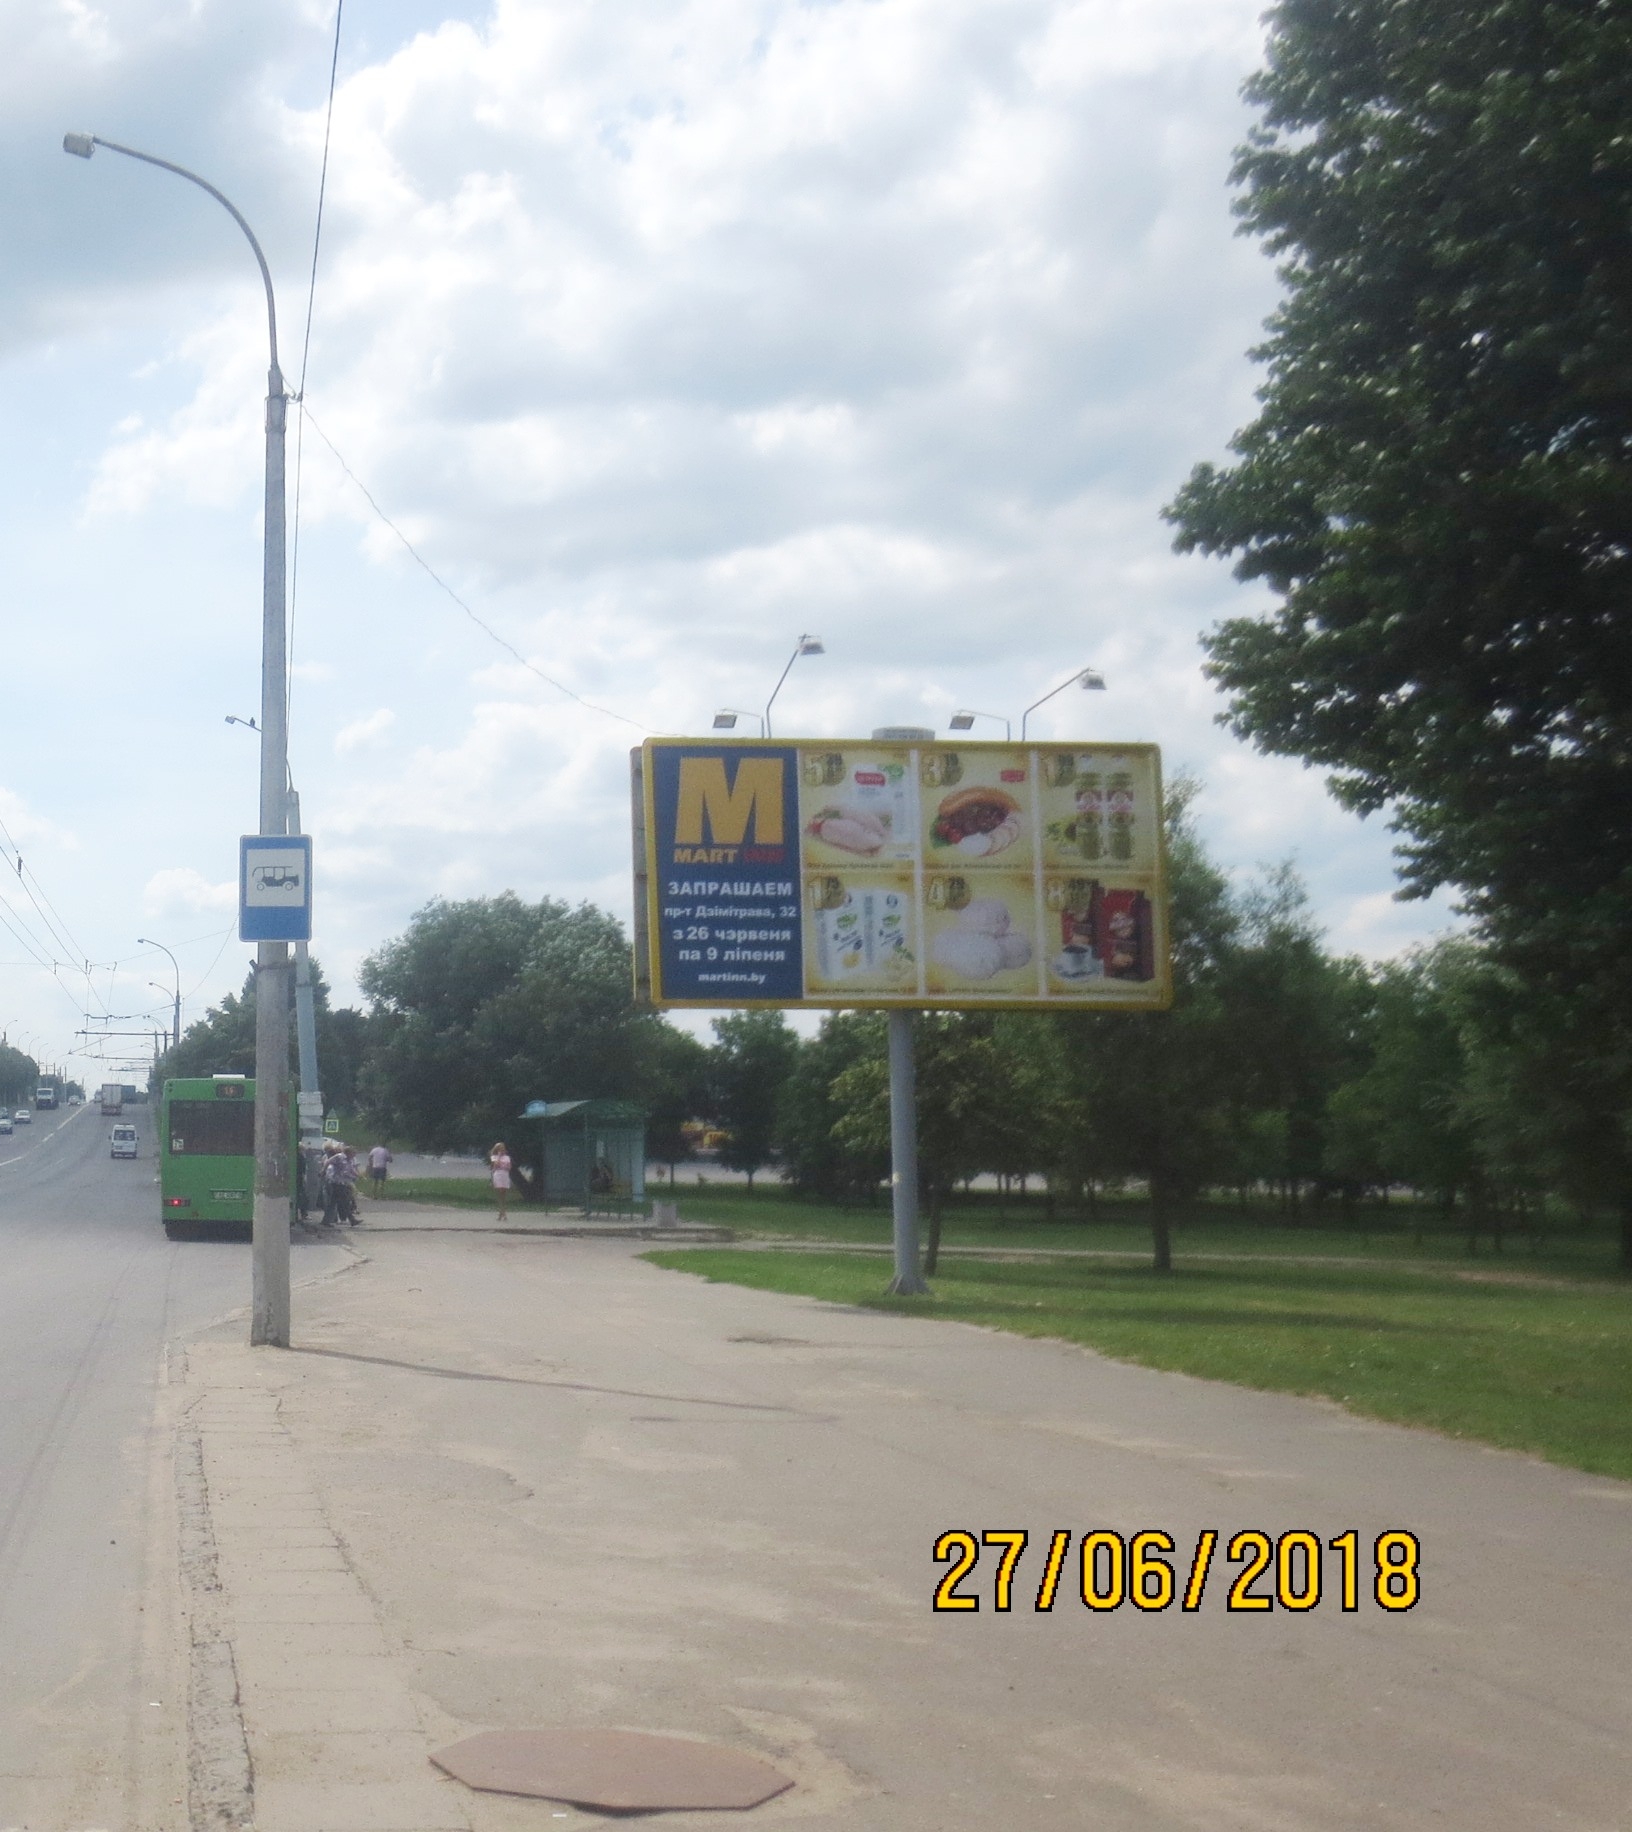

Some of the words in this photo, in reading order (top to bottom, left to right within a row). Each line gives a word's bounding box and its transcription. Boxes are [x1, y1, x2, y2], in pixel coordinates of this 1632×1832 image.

[674, 757, 784, 845] M
[673, 848, 738, 864] MART
[668, 881, 792, 896] ЗАПРАШАЕМ
[664, 907, 692, 919] пр-т
[779, 906, 797, 918] 32
[673, 929, 684, 940] з
[686, 926, 709, 941] 26
[715, 929, 791, 943] чэрвеня
[678, 949, 701, 961] па
[706, 946, 718, 961] 9
[723, 948, 785, 961] ліпеня
[698, 973, 766, 984] martinn.by
